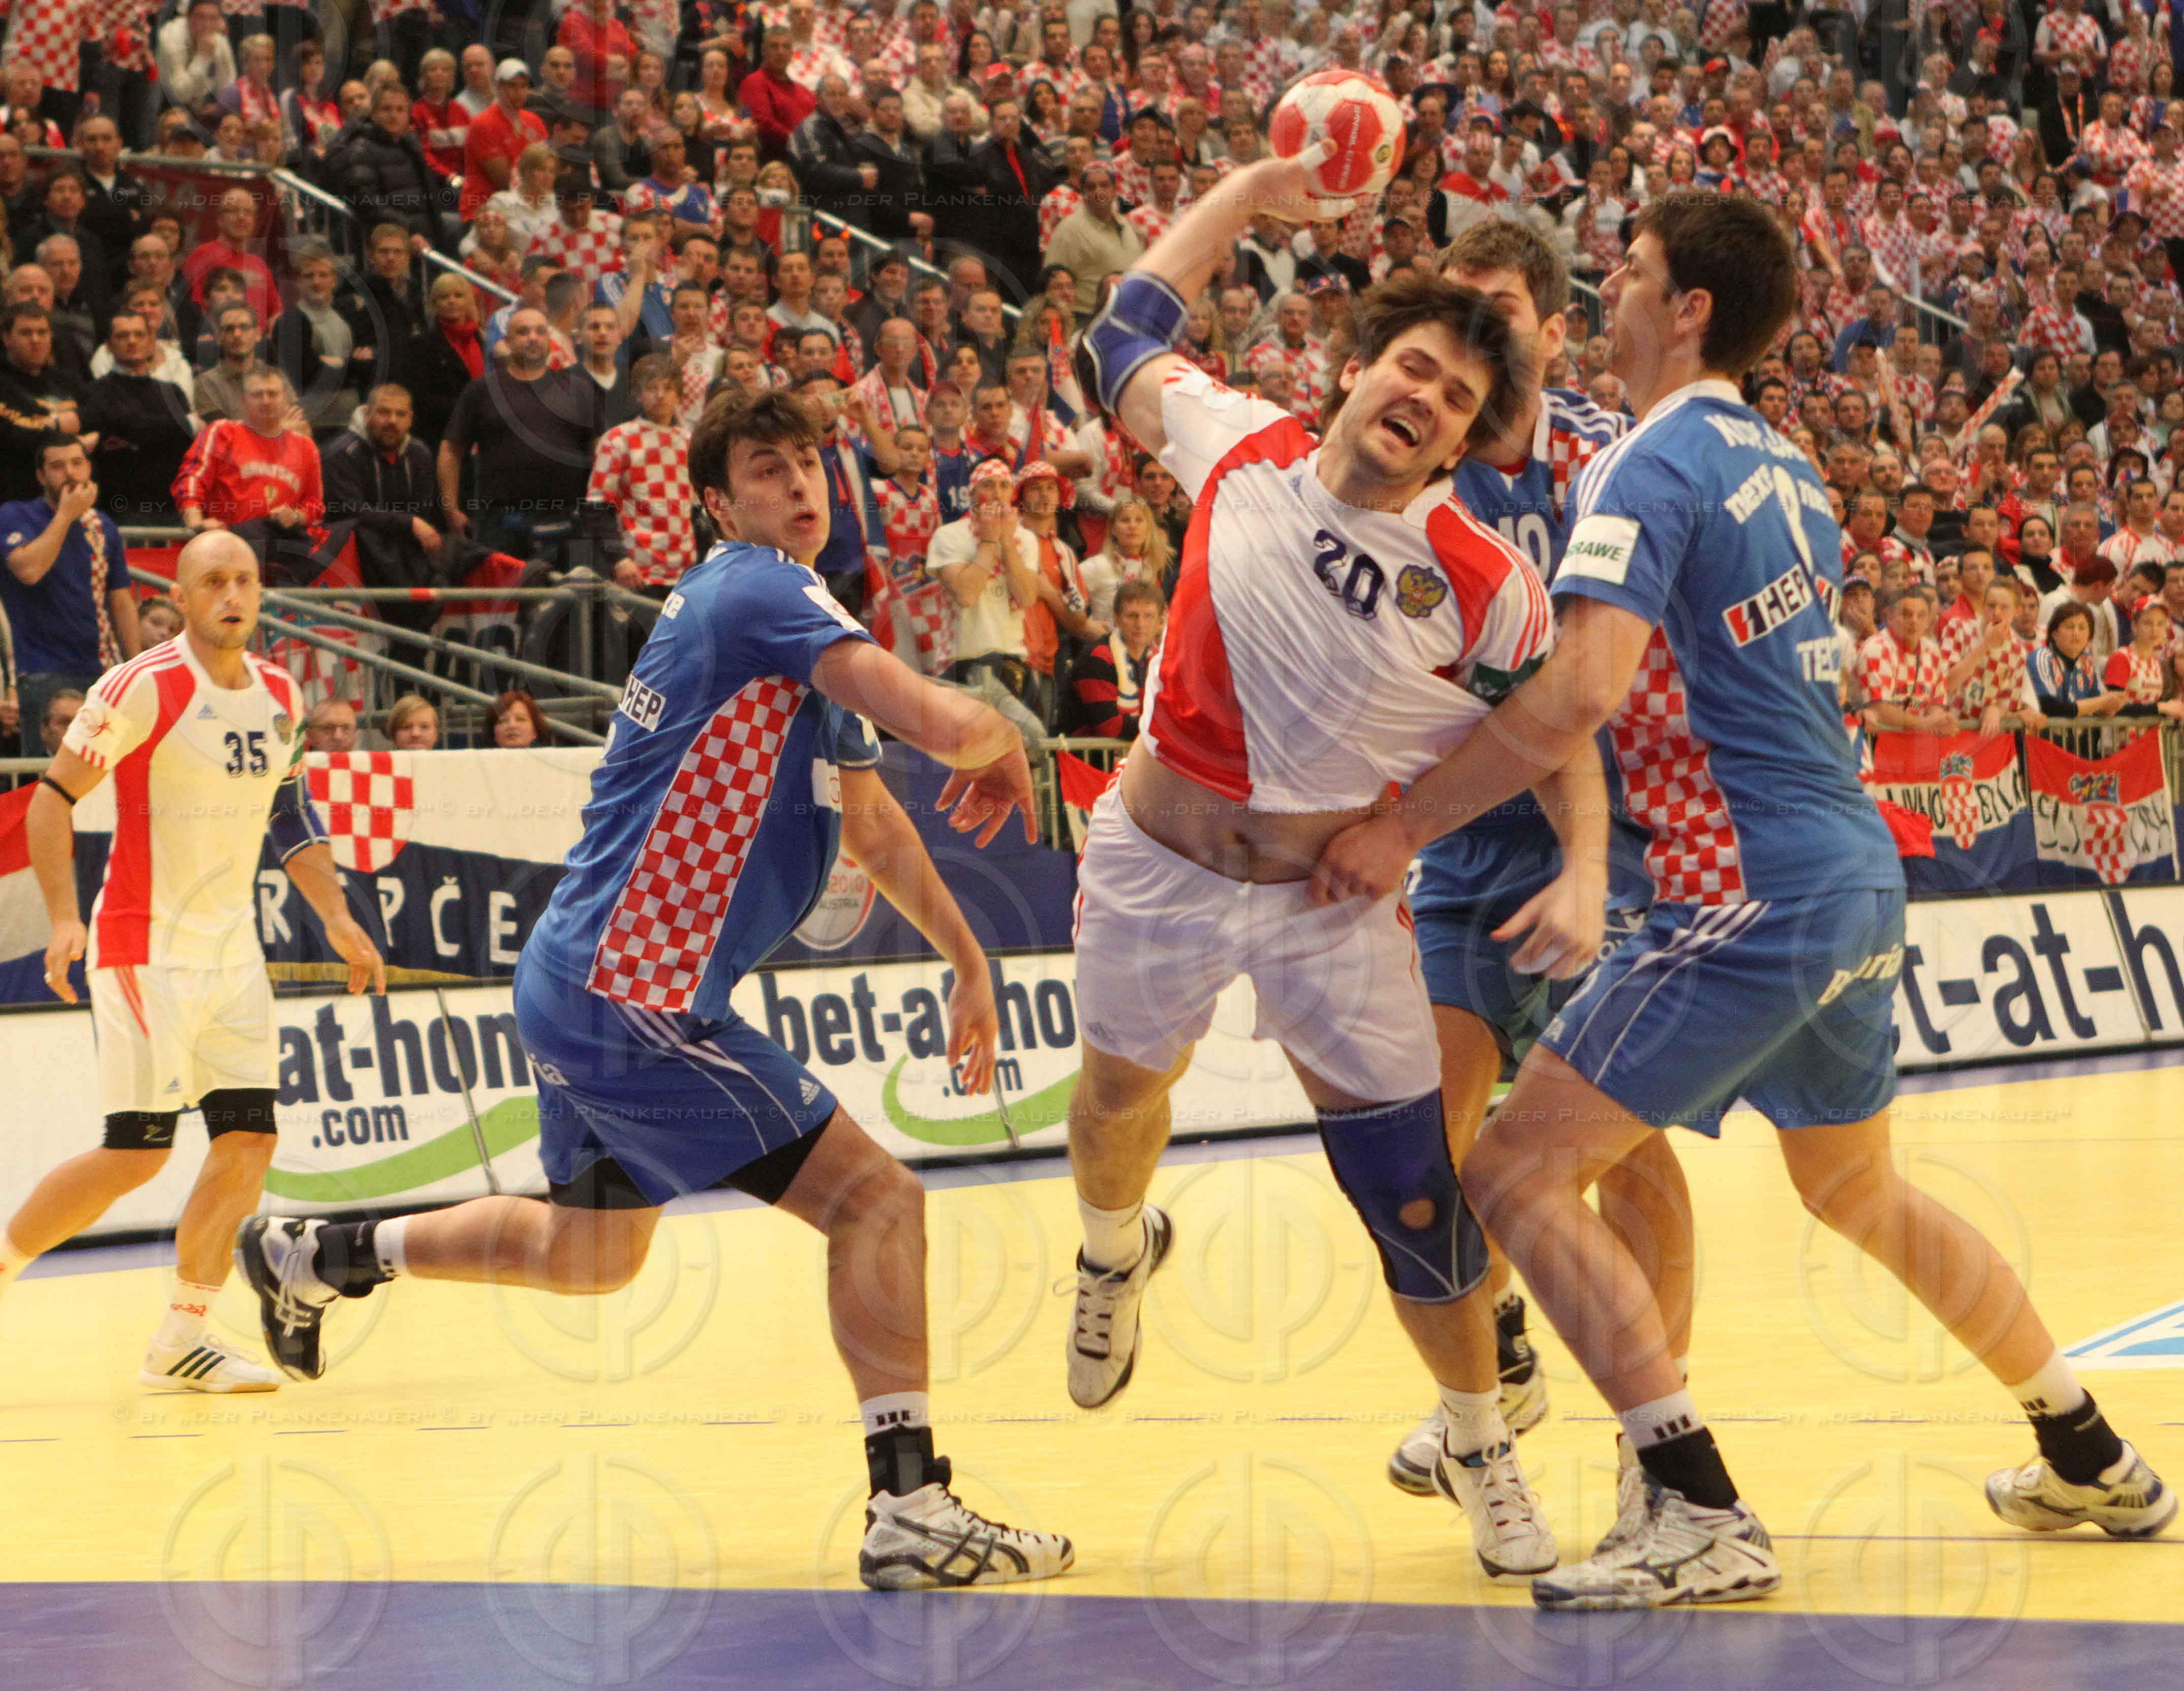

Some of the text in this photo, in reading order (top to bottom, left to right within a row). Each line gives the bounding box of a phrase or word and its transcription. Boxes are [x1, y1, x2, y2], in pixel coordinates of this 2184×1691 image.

[1313, 529, 1385, 621] 20
[224, 731, 270, 778] 35
[312, 1103, 409, 1149] .com
